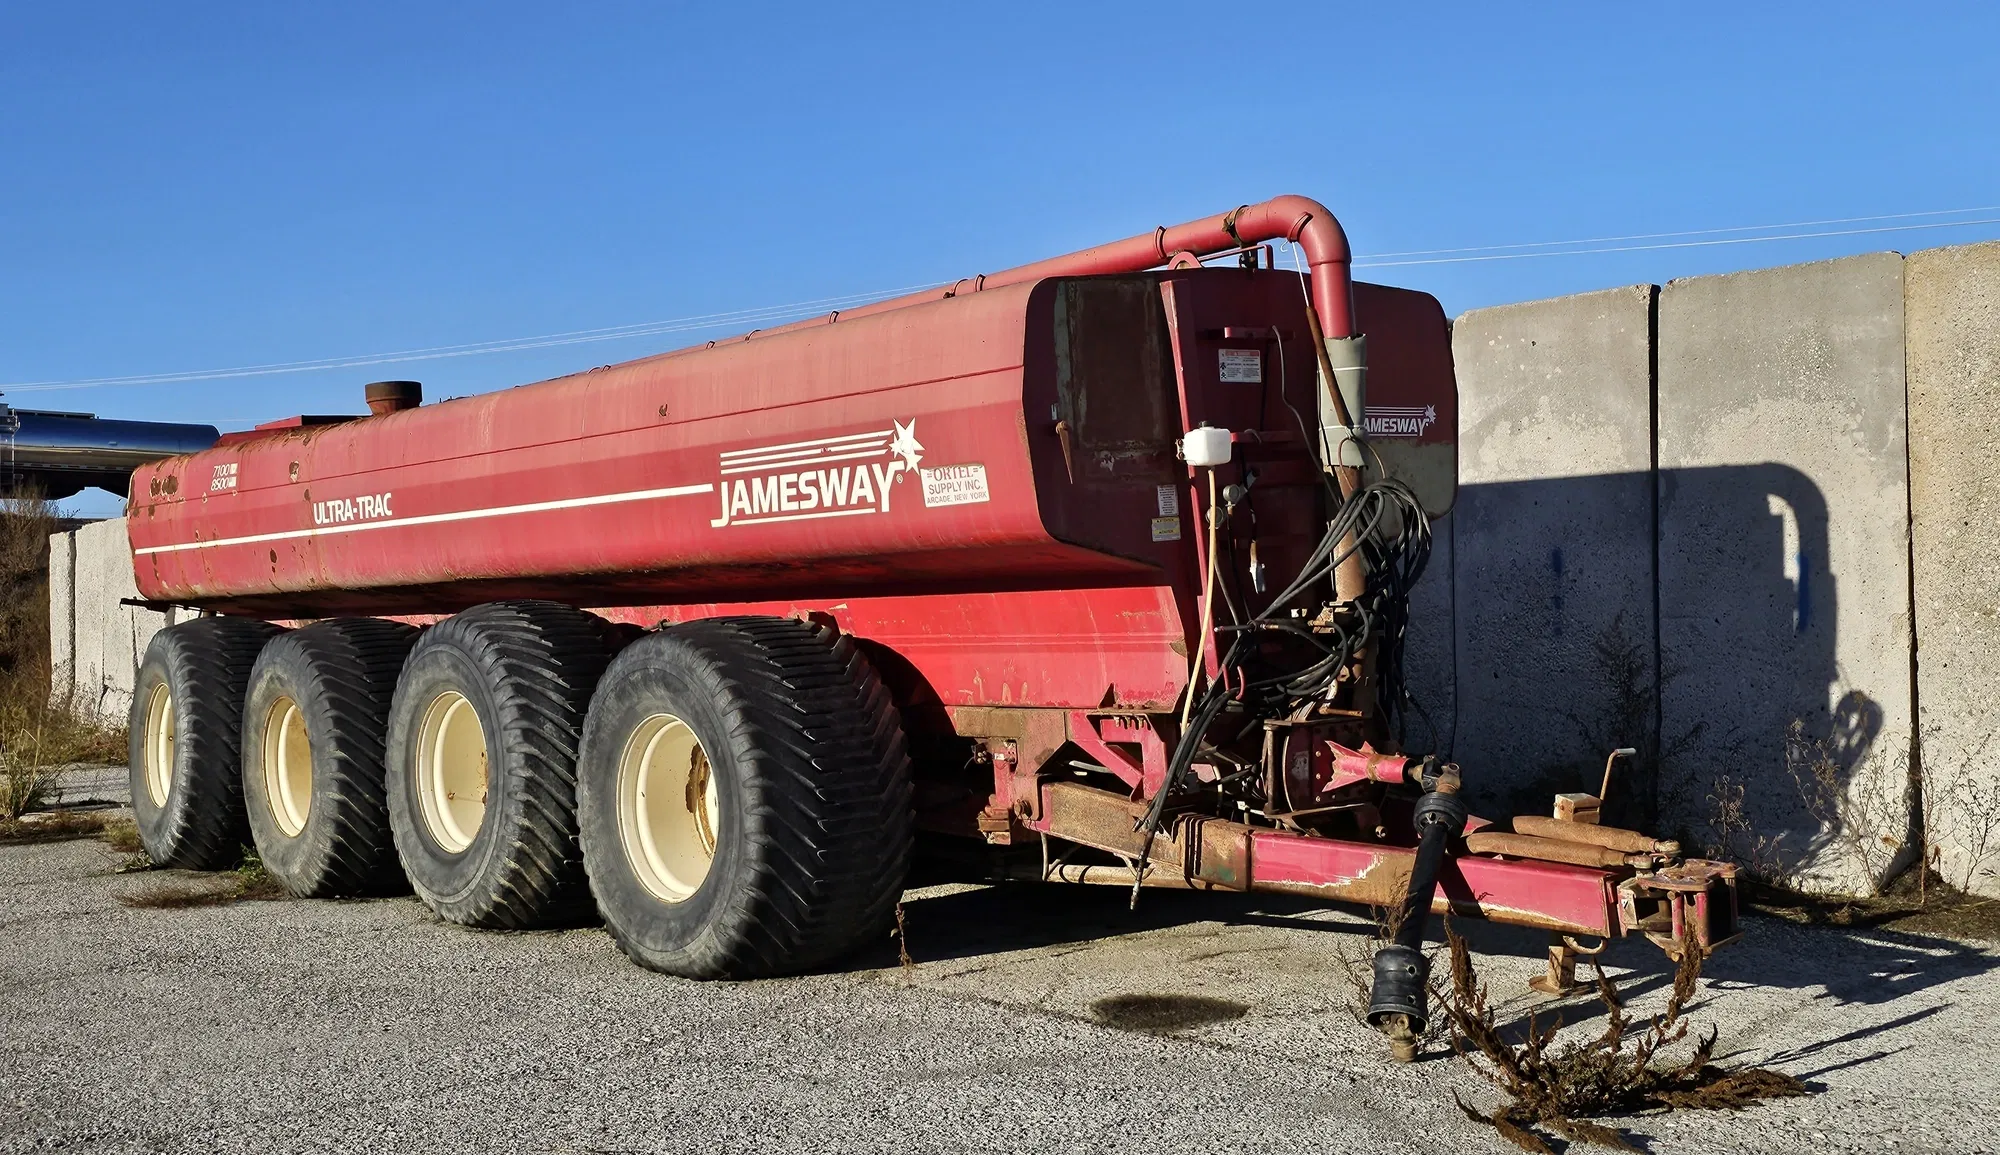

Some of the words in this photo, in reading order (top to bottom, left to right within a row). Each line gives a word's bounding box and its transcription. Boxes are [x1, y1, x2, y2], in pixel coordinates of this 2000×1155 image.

[1362, 417, 1429, 437] AMESWAY
[212, 463, 230, 478] 7100
[210, 477, 229, 491] 8500
[928, 480, 962, 495] SUPPLY
[964, 479, 983, 491] INC.
[710, 460, 904, 528] JAMESWAY
[953, 493, 968, 502] NEW
[969, 490, 987, 500] YORK
[313, 492, 393, 525] ULTRA-TRAC
